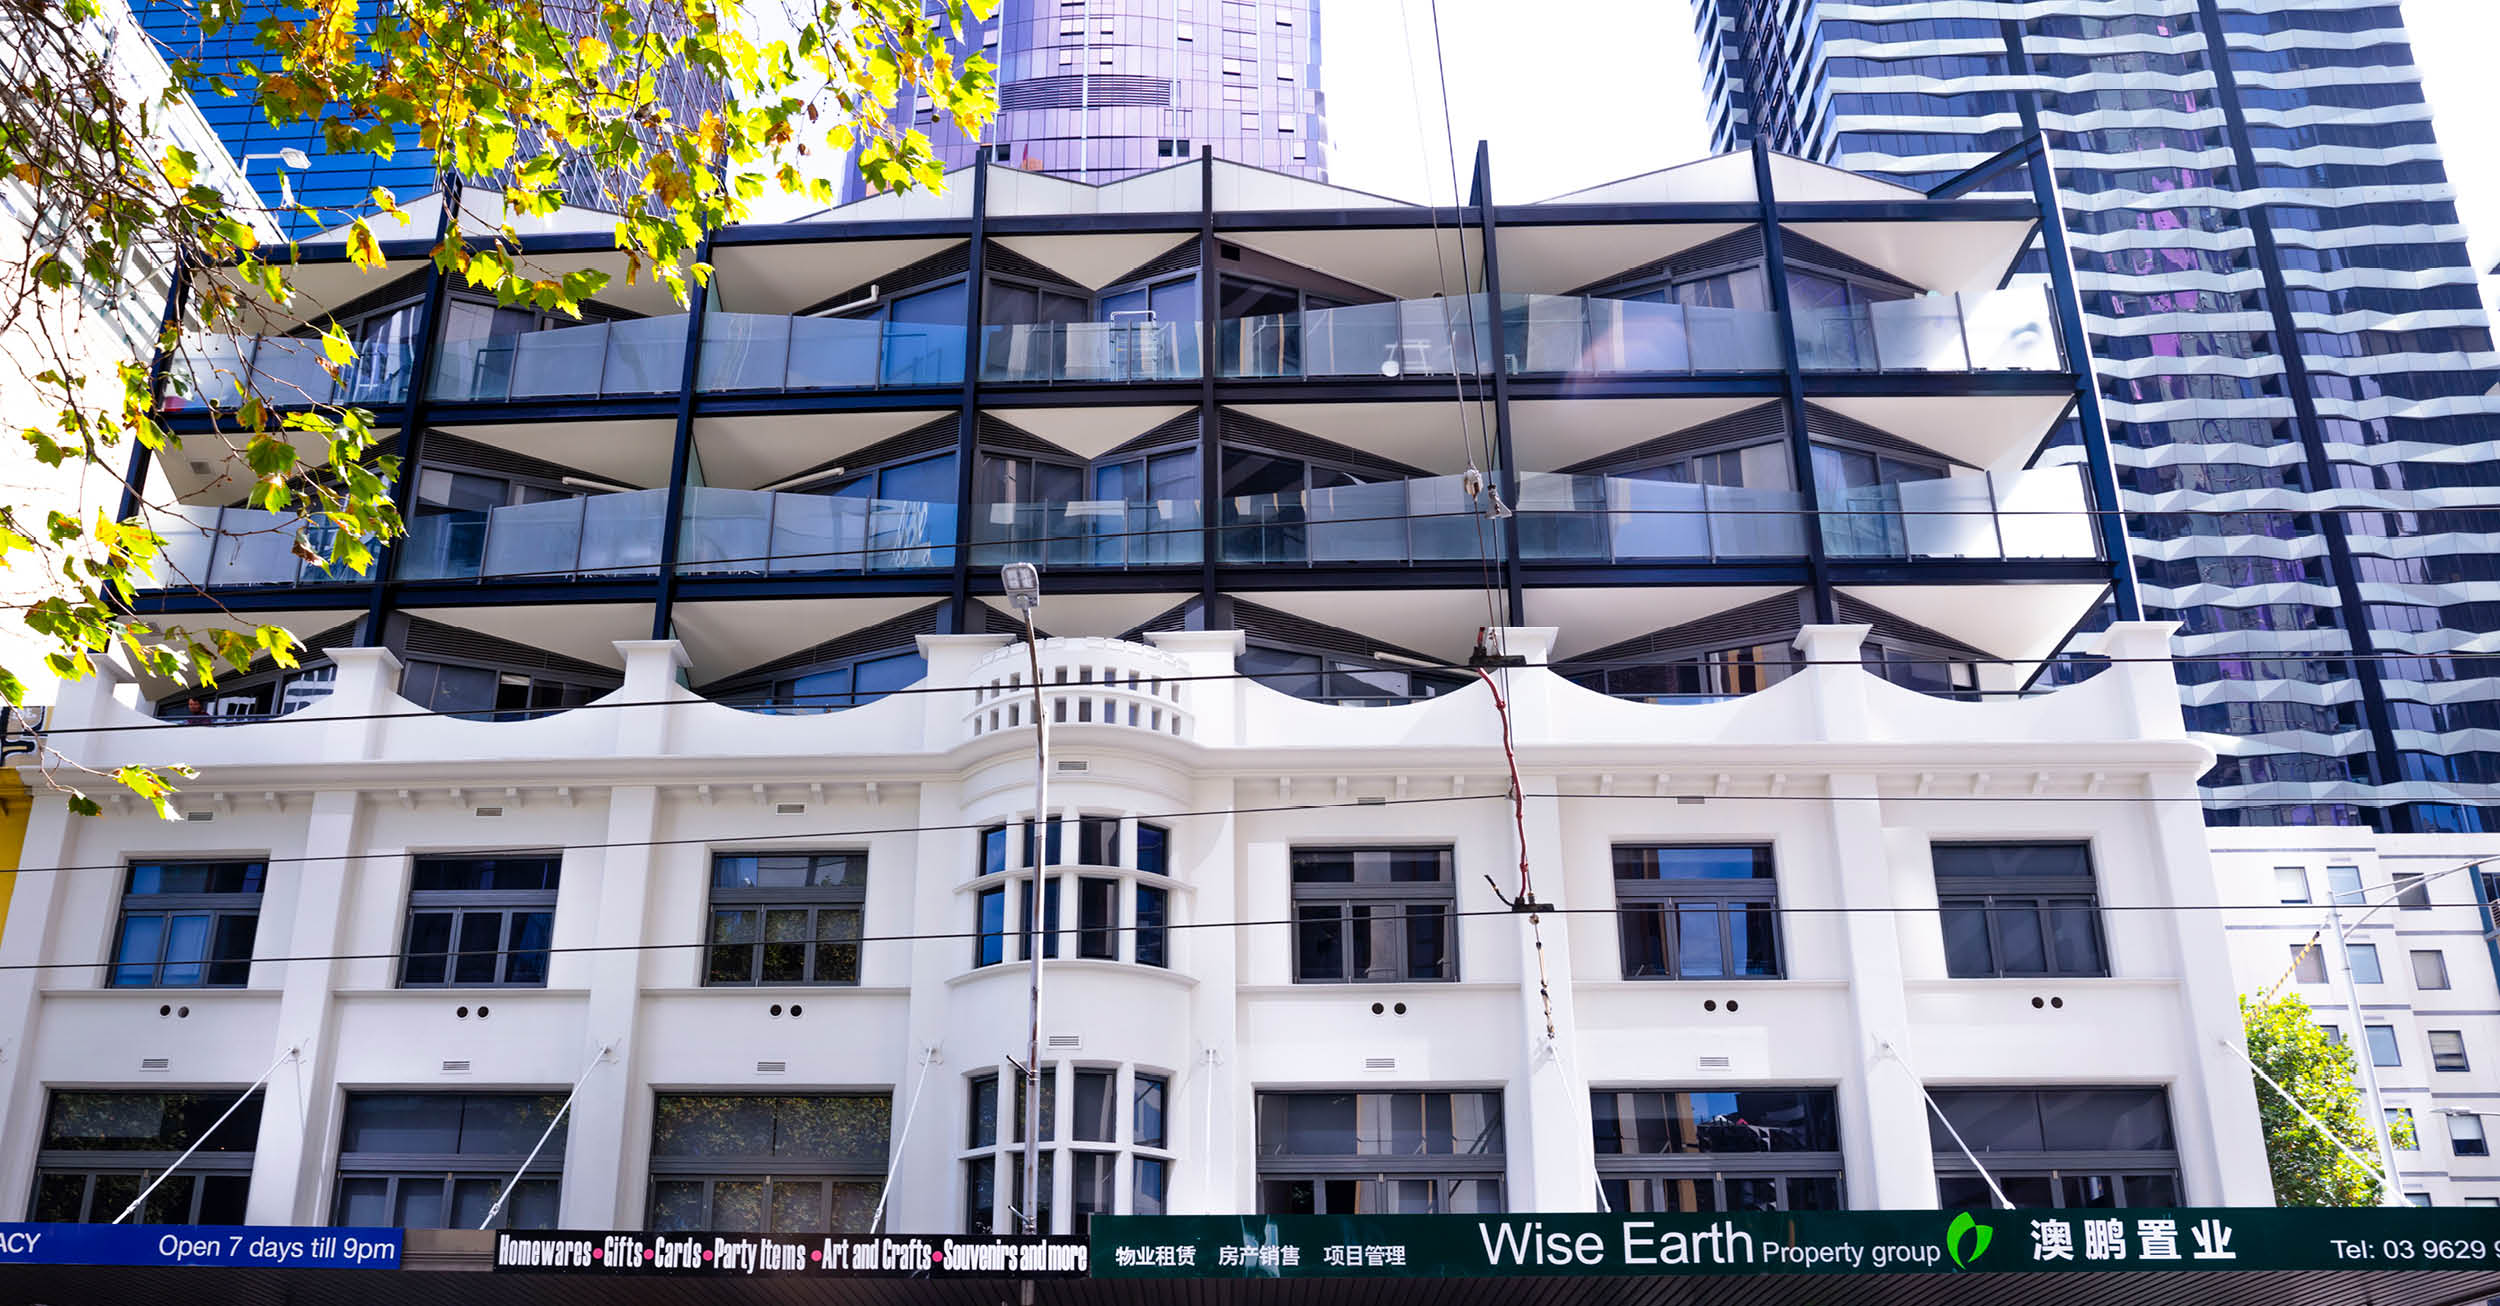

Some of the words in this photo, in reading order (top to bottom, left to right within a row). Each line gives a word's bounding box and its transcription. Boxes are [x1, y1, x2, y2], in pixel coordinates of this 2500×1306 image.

[159, 1234, 221, 1261] Open
[229, 1237, 243, 1257] 7
[249, 1236, 304, 1263] days
[311, 1238, 336, 1259] till
[343, 1238, 395, 1264] 9pm
[498, 1234, 592, 1267] Homewares
[603, 1235, 643, 1268] Gifts
[654, 1236, 702, 1269] Cards
[713, 1237, 758, 1274] Party
[760, 1238, 806, 1271] Items
[821, 1238, 849, 1270] Art
[852, 1239, 879, 1270] and
[882, 1238, 932, 1271] Crafts
[943, 1238, 1018, 1272] Souvenirs
[1019, 1239, 1047, 1271] and
[1047, 1245, 1088, 1272] more
[1115, 1245, 1197, 1267] 物业租赁
[1218, 1245, 1301, 1267] 房产销售
[1323, 1245, 1406, 1267] 项目管理
[1478, 1221, 1604, 1265] Wise
[1623, 1220, 1754, 1265] Earth
[1762, 1241, 1865, 1268] Property
[1871, 1245, 1941, 1268] group
[2030, 1217, 2237, 1261] 澳鹏置业
[2330, 1239, 2375, 1260] Tel:
[2383, 1239, 2416, 1259] 03
[2422, 1239, 2487, 1259] 9629
